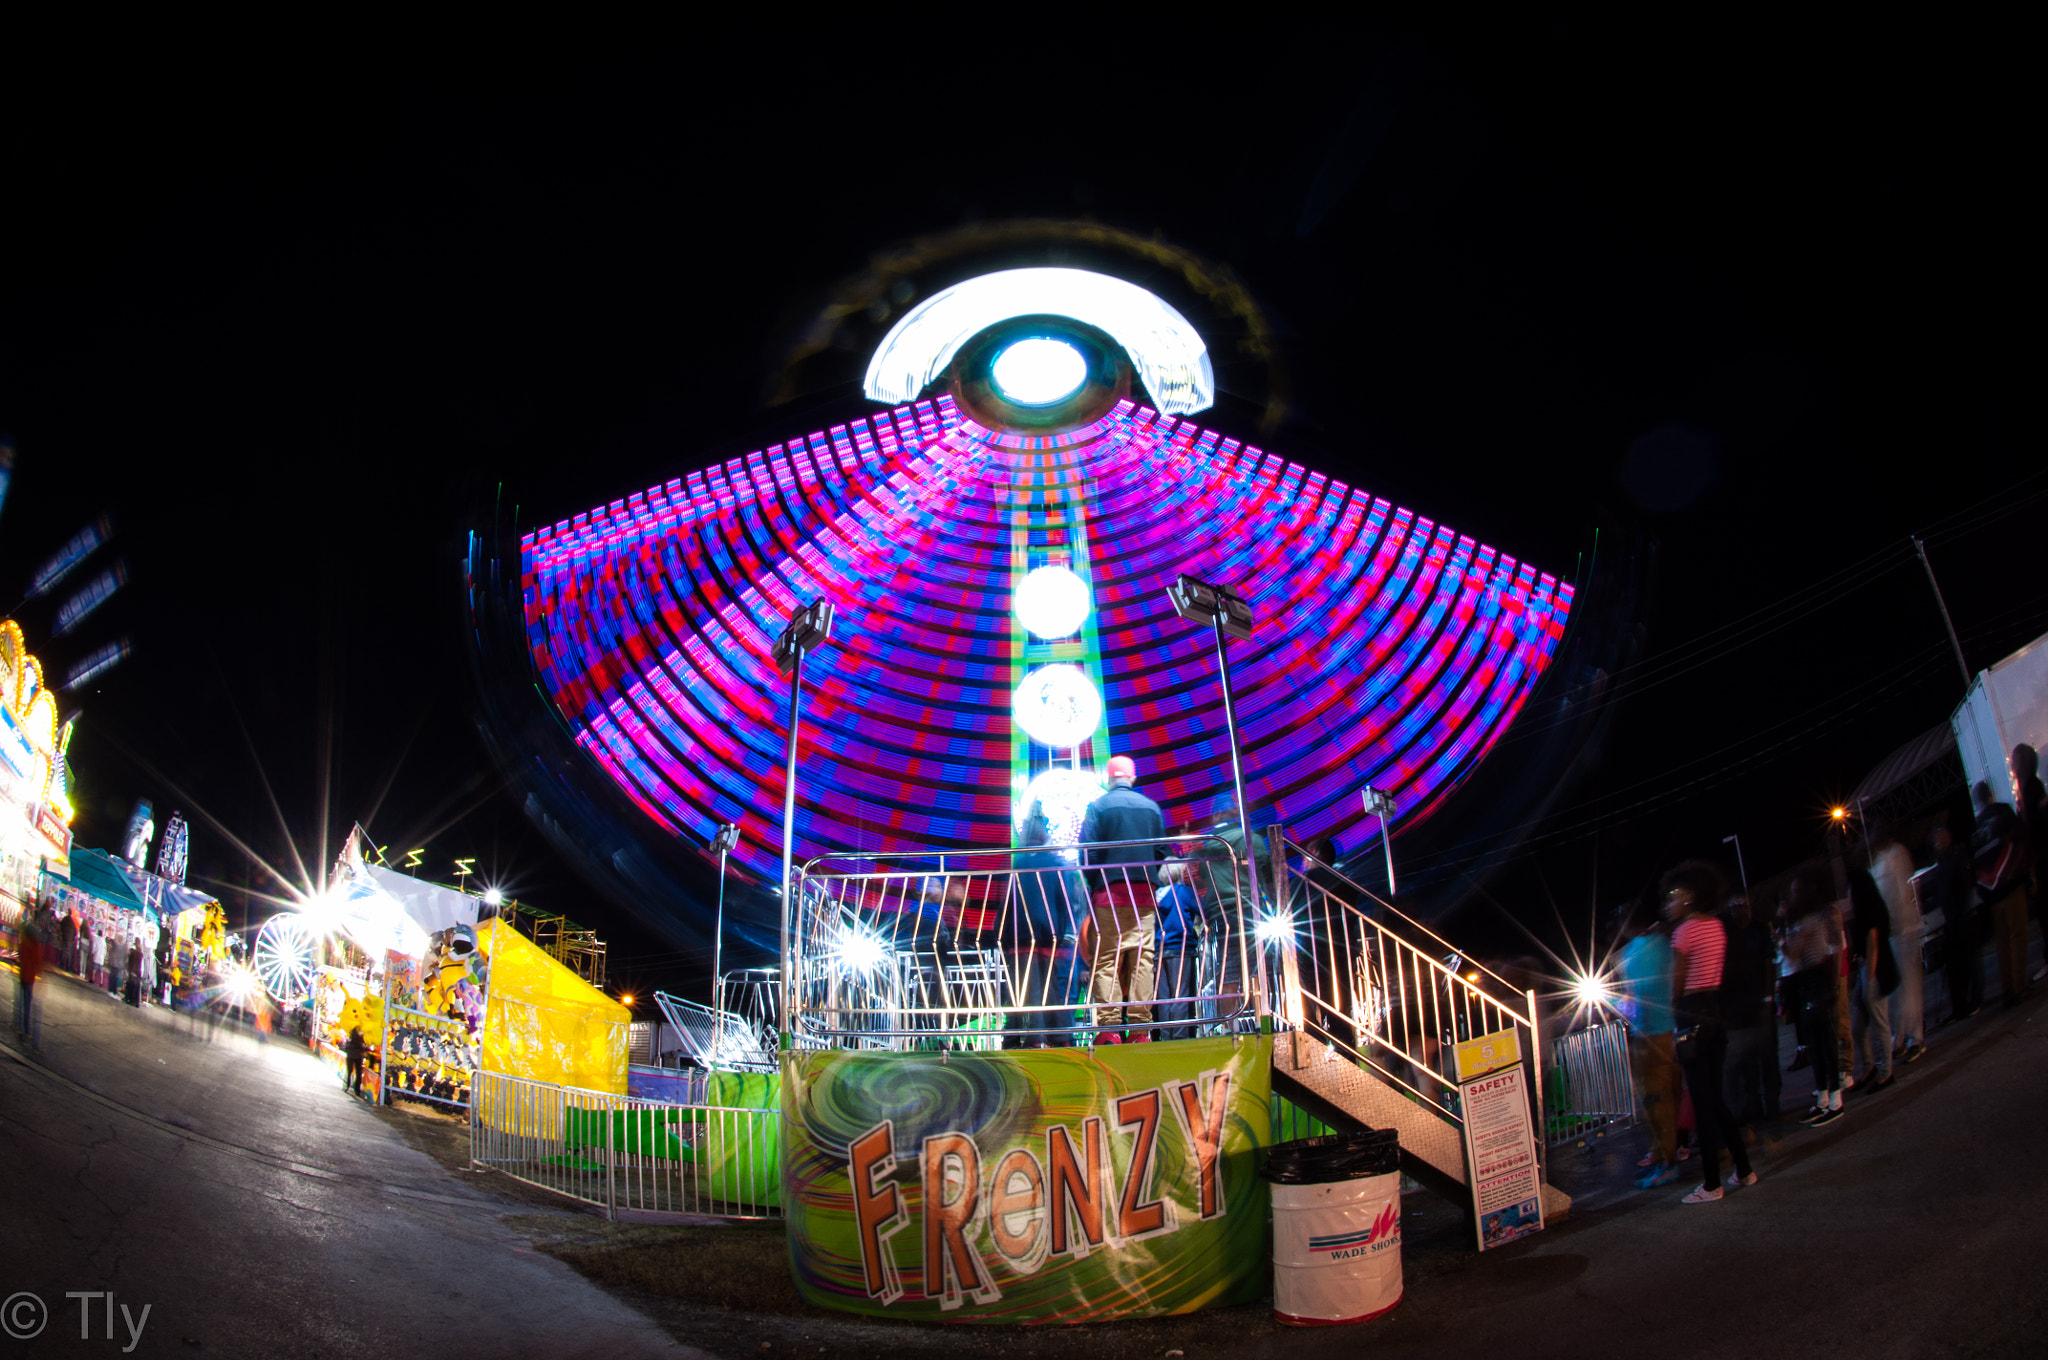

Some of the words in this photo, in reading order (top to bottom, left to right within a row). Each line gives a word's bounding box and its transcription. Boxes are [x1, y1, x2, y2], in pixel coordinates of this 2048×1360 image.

[1481, 1044, 1495, 1059] 5
[1472, 1056, 1508, 1071] Tickets
[1470, 1074, 1515, 1096] SAFETY
[1480, 1169, 1531, 1190] ATTENTION
[1331, 1246, 1367, 1260] WADE
